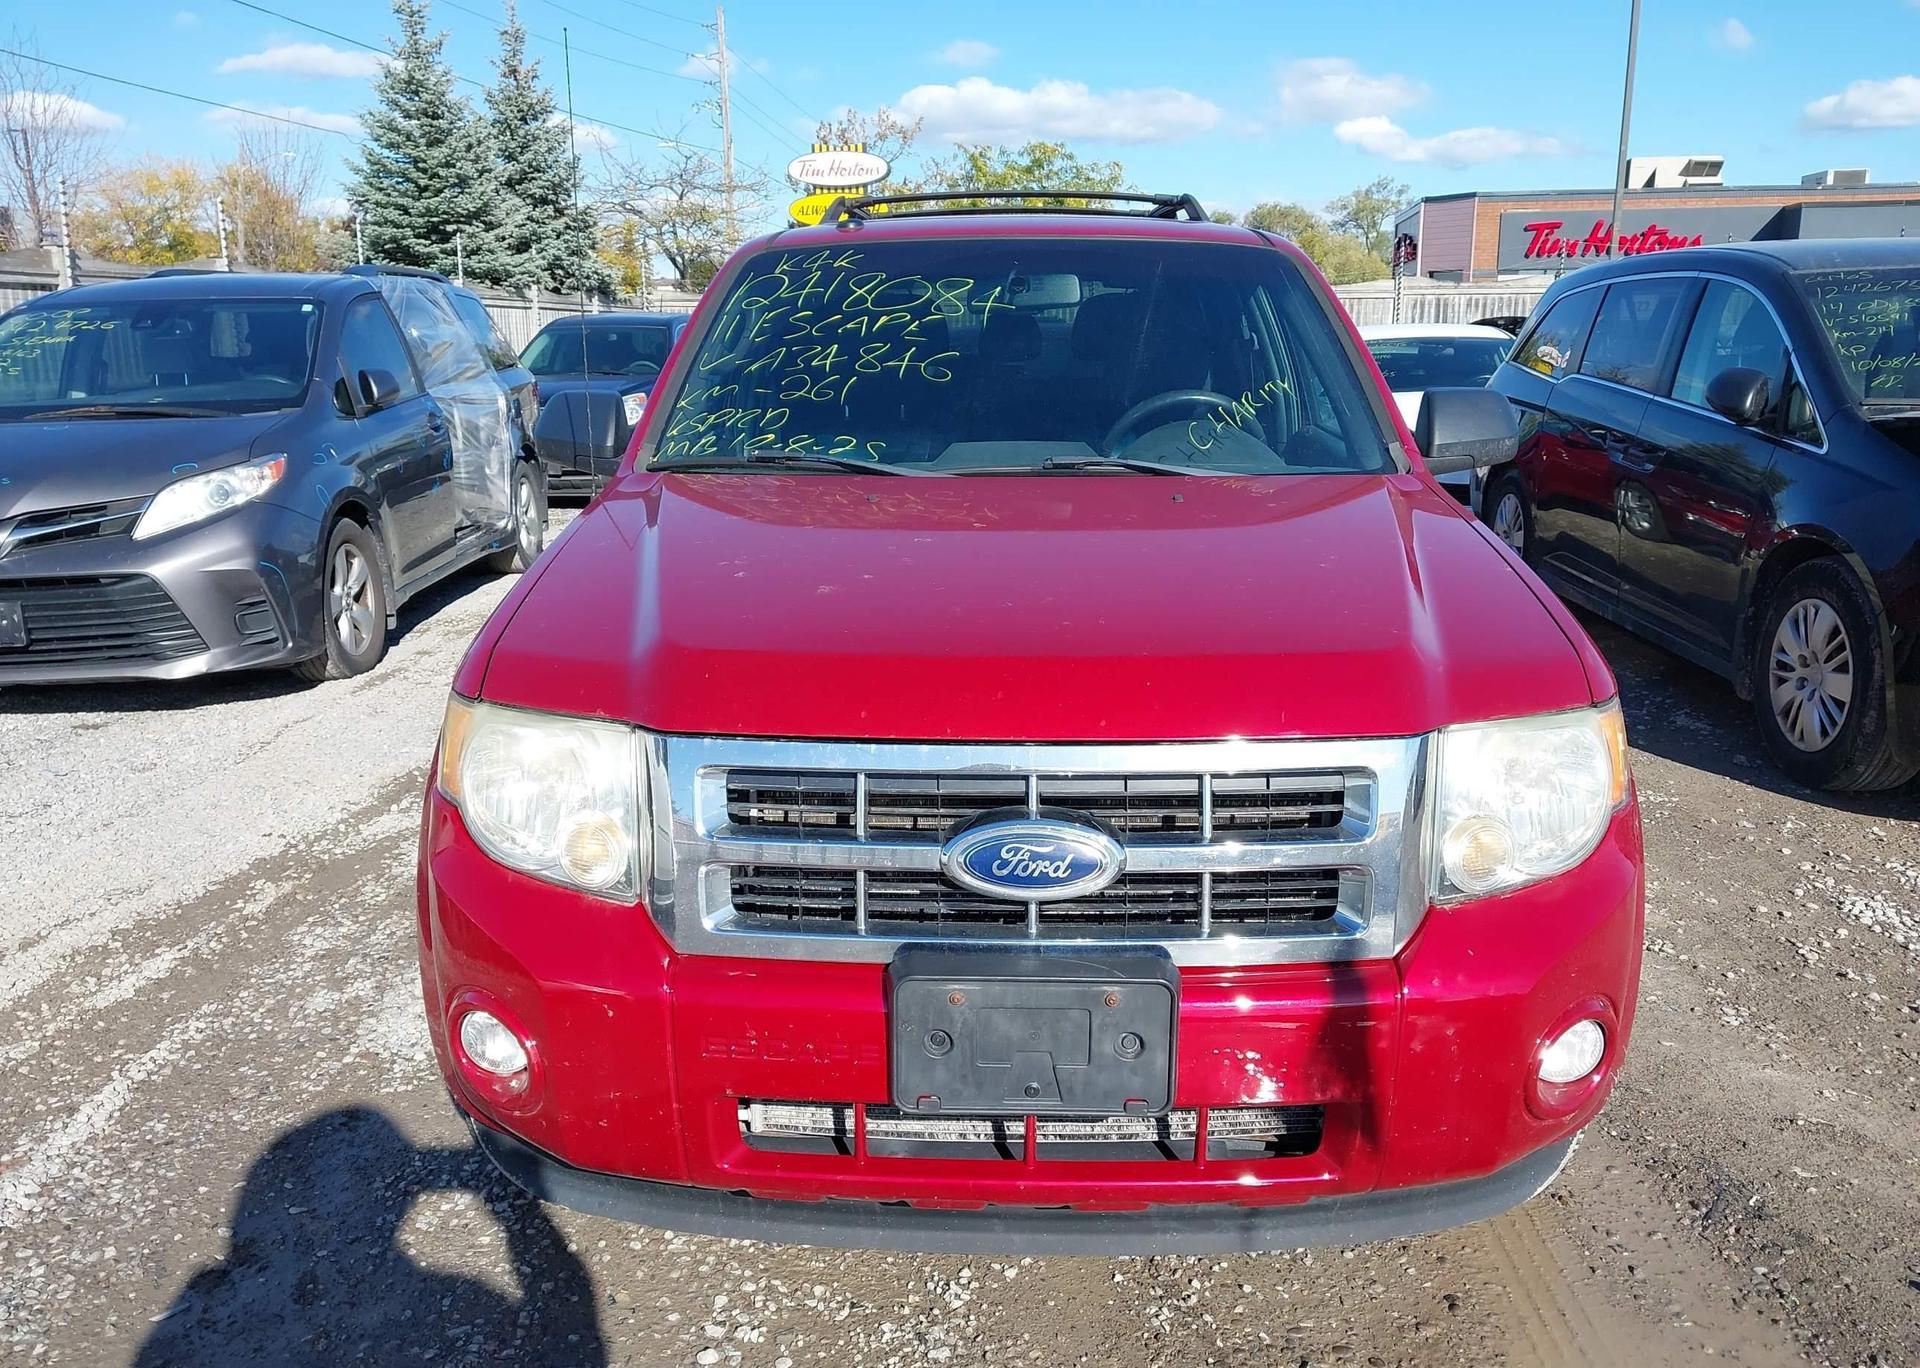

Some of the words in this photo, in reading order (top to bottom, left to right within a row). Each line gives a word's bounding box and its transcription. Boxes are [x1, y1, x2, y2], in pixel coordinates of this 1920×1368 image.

[797, 159, 825, 178] Tim
[827, 159, 880, 178] Hortons
[1523, 221, 1580, 259] Tim
[724, 271, 1016, 328] 12418084
[1187, 374, 1297, 450] CHARITY
[992, 843, 1075, 878] Ford
